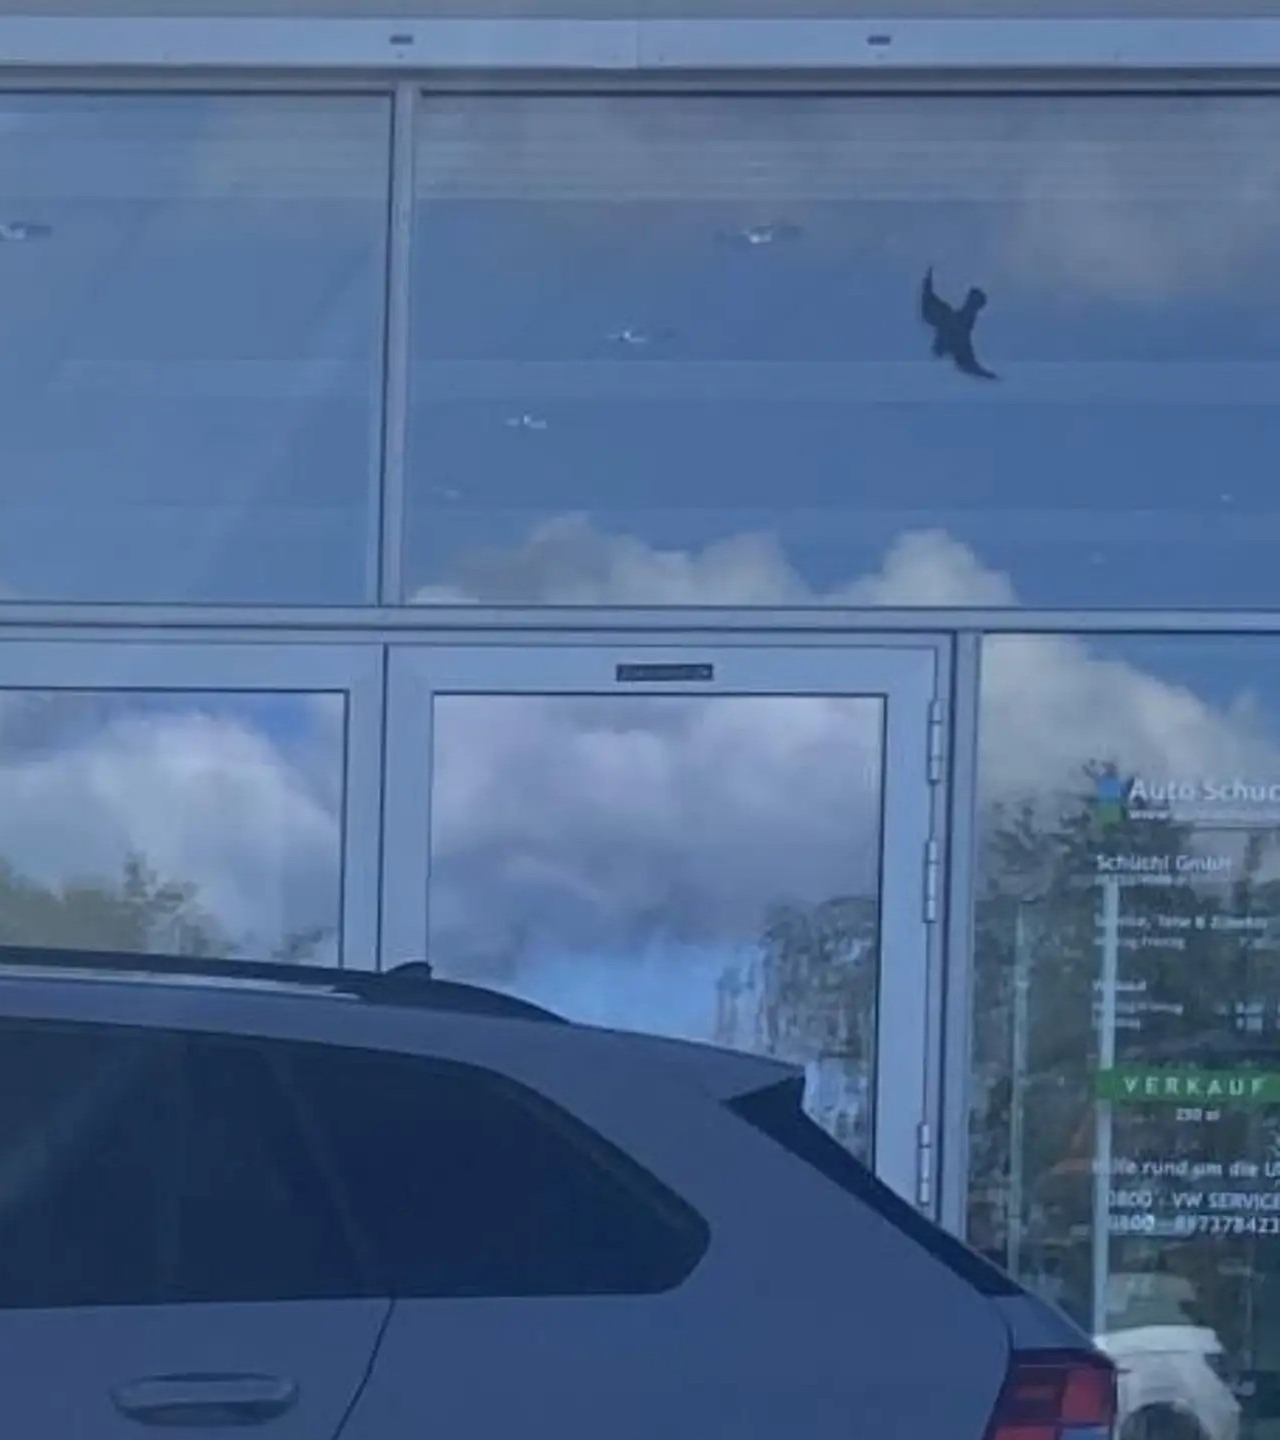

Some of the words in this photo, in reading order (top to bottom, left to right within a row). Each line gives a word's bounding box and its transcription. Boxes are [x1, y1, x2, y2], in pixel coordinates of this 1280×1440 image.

[1129, 778, 1195, 800] Auto
[1123, 1076, 1267, 1096] VERKAUF
[1172, 1192, 1203, 1208] VW
